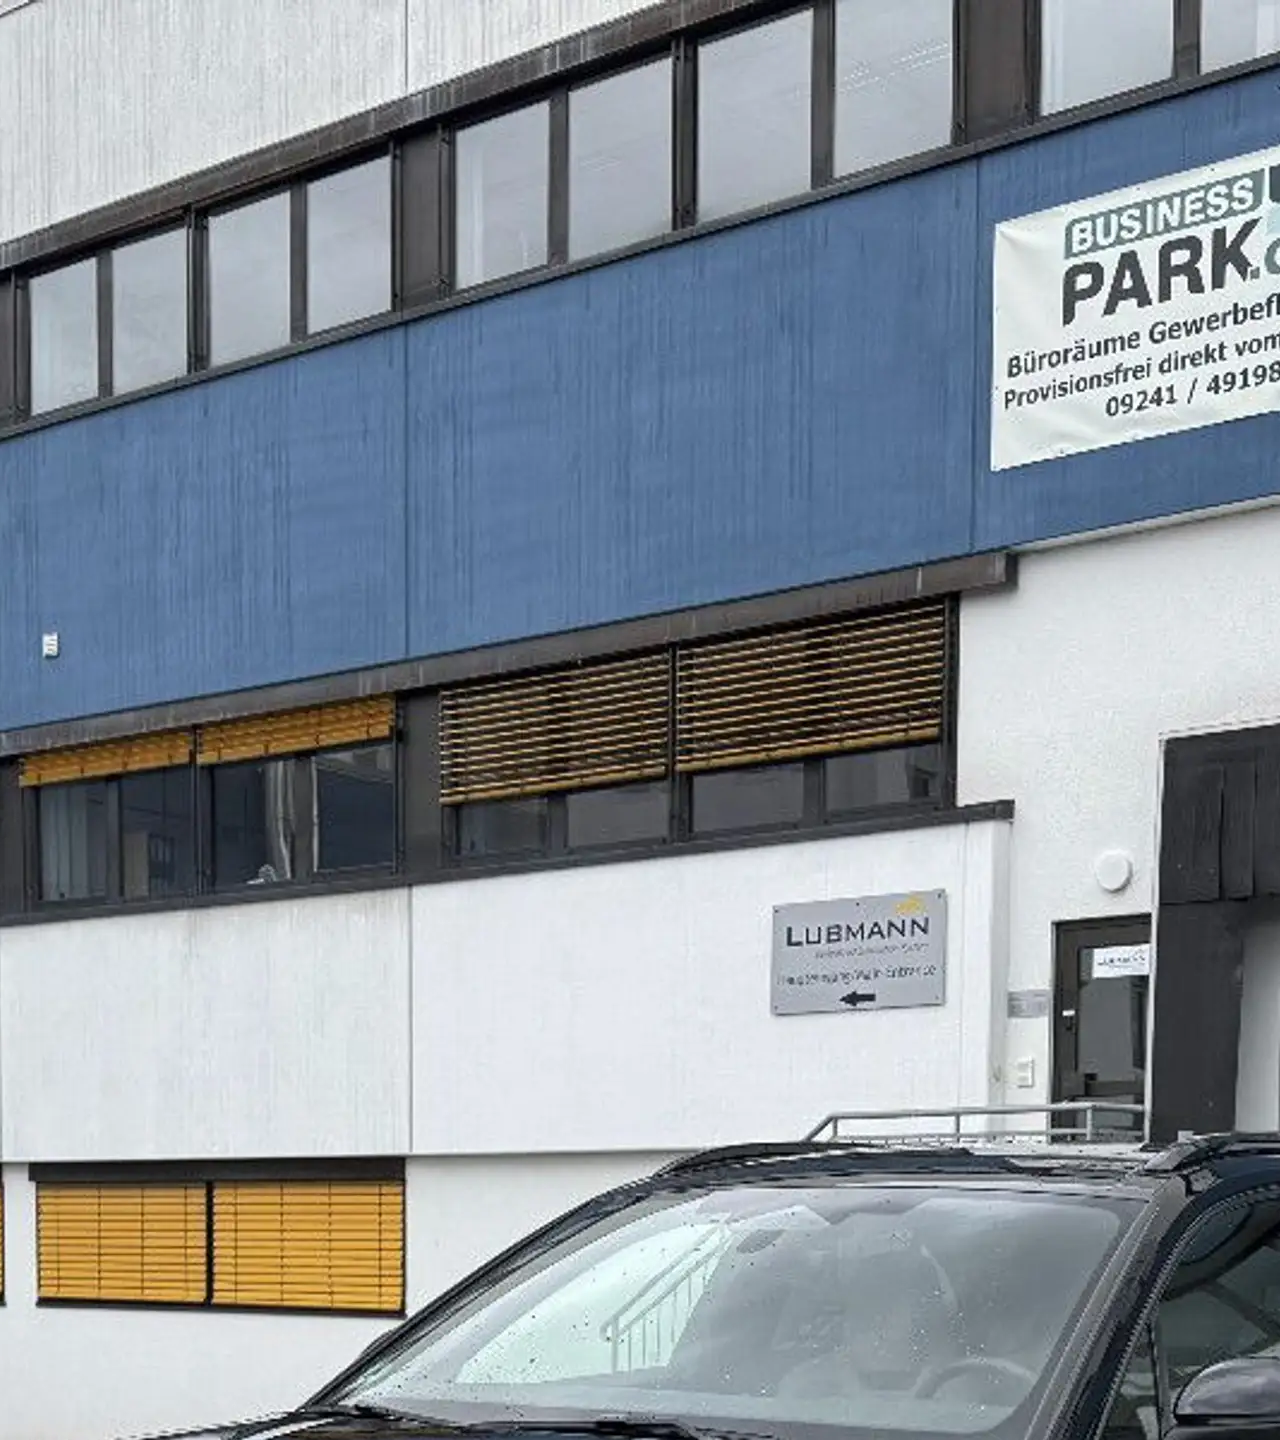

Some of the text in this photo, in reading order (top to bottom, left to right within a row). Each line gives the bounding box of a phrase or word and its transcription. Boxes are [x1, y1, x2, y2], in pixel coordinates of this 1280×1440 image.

[1070, 176, 1255, 253] BUSINESS
[1004, 358, 1152, 411] Provisionsfrei
[1159, 341, 1227, 373] direkt
[1007, 331, 1140, 378] Büroräume
[1105, 384, 1178, 417] 09241
[1187, 377, 1199, 404] /
[785, 916, 930, 947] LUBMANN
